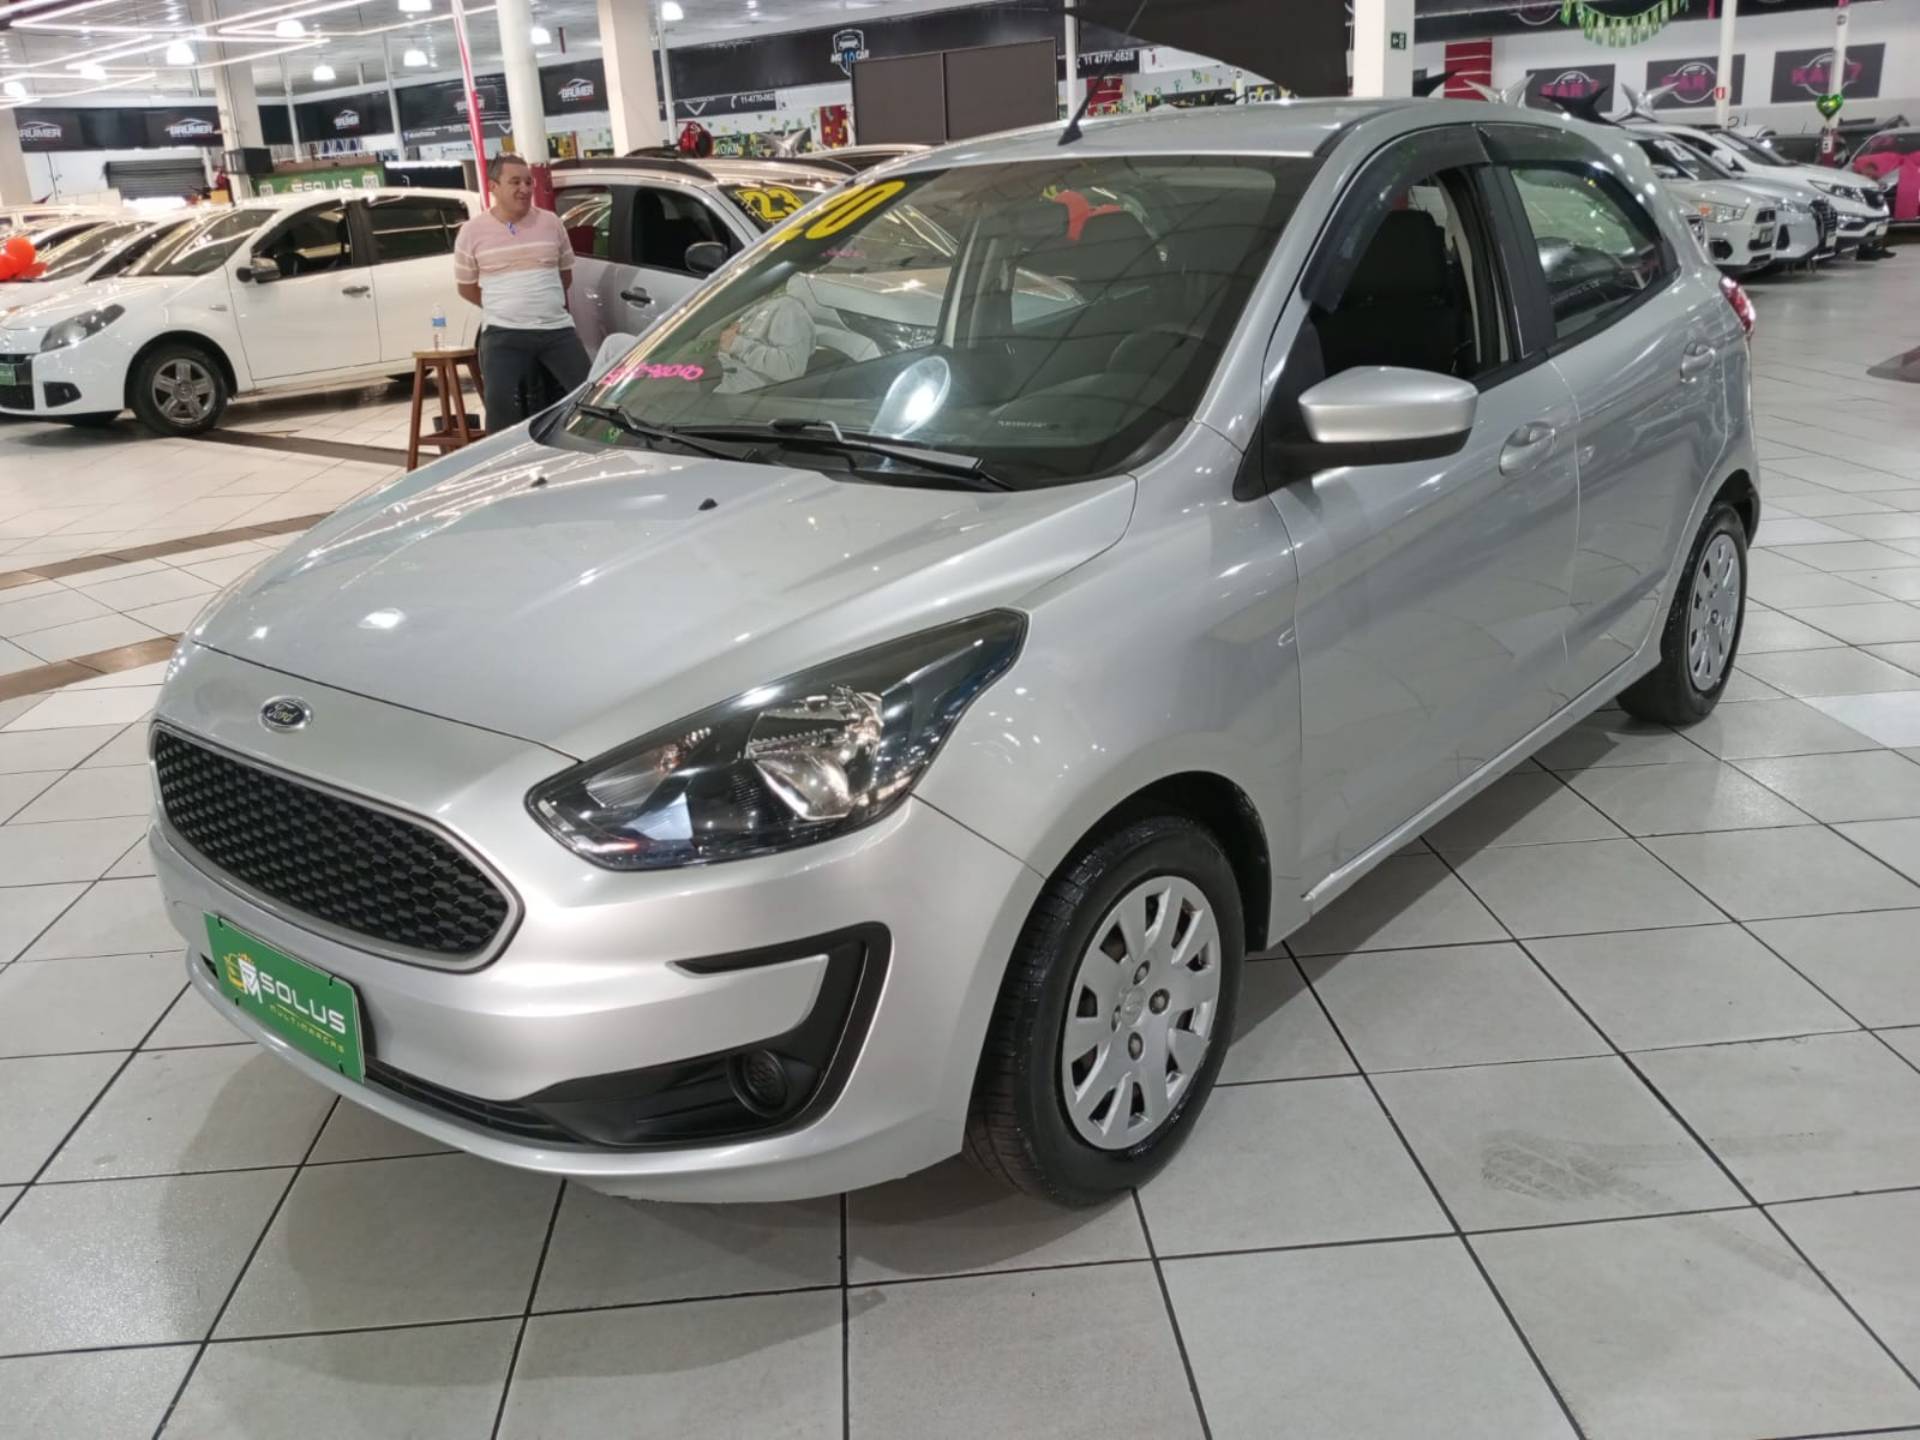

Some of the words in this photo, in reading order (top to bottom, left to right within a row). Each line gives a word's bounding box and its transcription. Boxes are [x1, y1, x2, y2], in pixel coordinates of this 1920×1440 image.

[265, 702, 301, 723] Ford
[258, 970, 347, 1035] SOLUS
[268, 1003, 346, 1054] MULTIMARCAS
